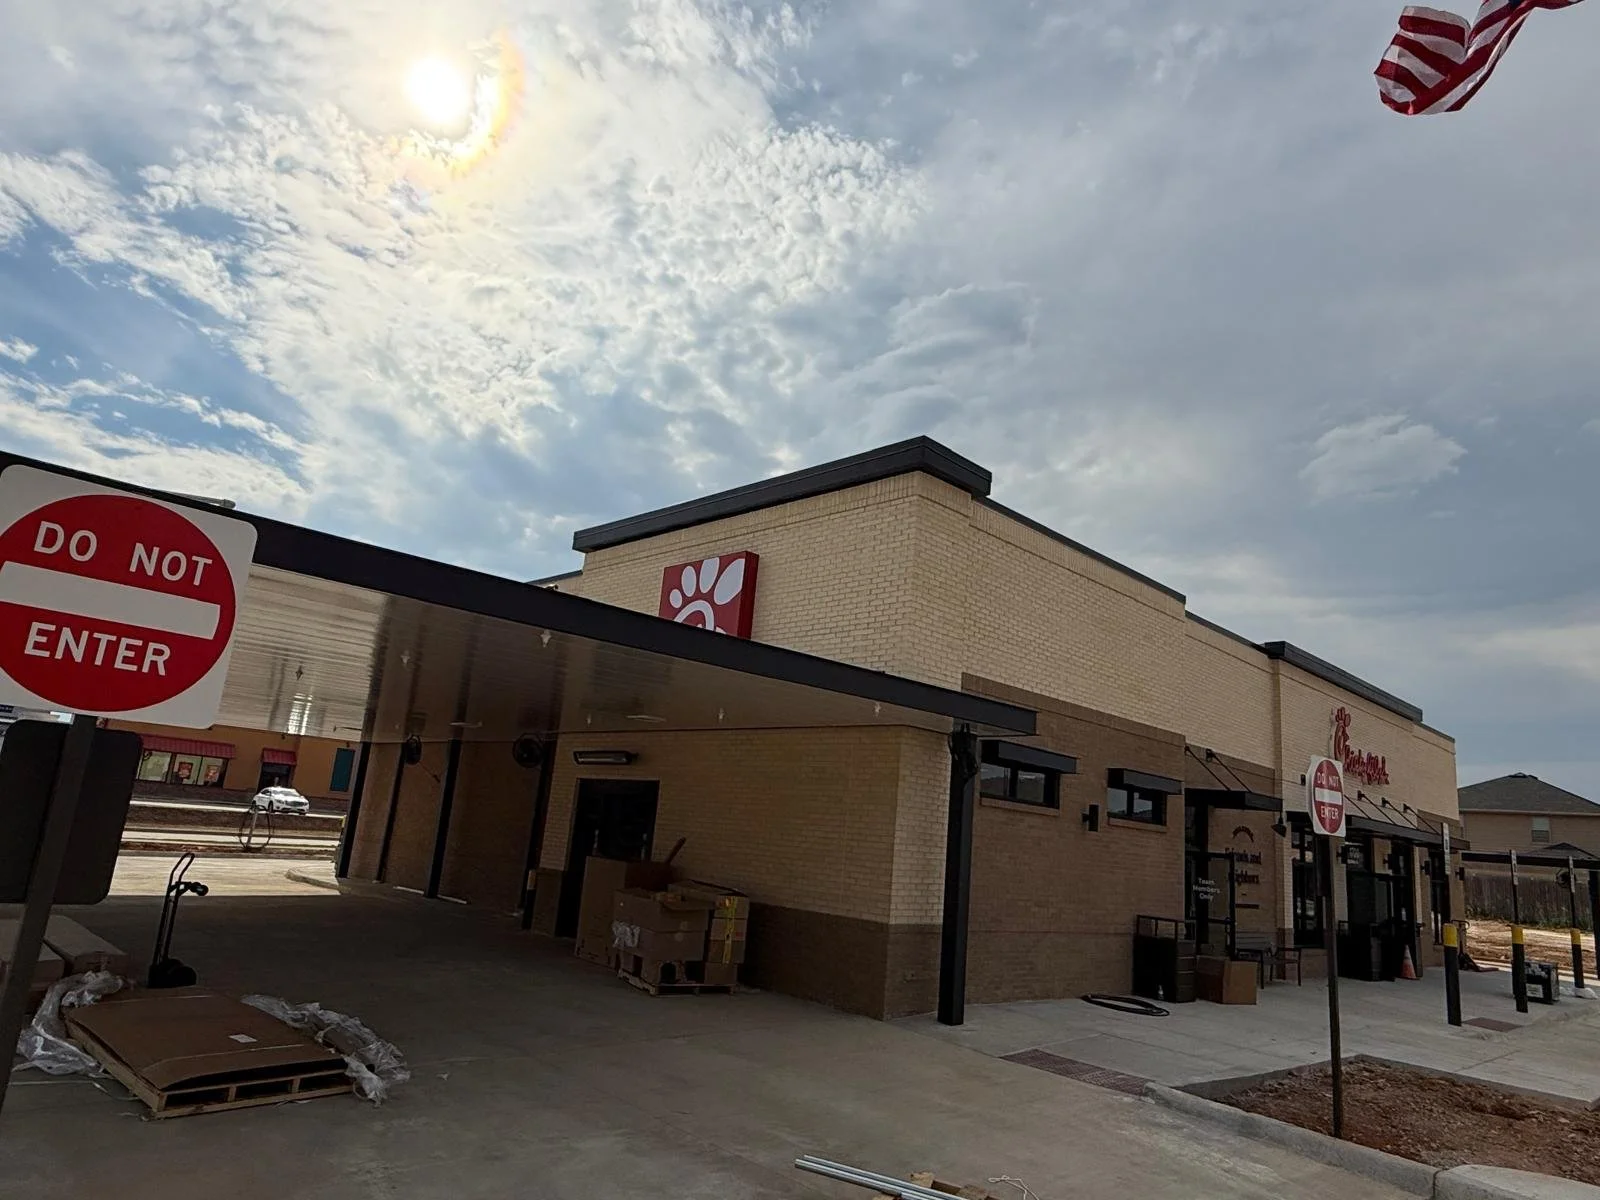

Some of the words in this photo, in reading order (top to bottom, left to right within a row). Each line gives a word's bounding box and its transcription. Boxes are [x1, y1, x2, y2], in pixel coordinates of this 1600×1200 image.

[33, 520, 97, 562] DO
[129, 542, 213, 586] NOT
[24, 621, 171, 676] ENTER
[1317, 772, 1326, 785] DO
[1329, 775, 1339, 788] NOT
[1320, 805, 1339, 820] ENTER
[1192, 885, 1221, 894] Members
[1199, 892, 1214, 902] Only
